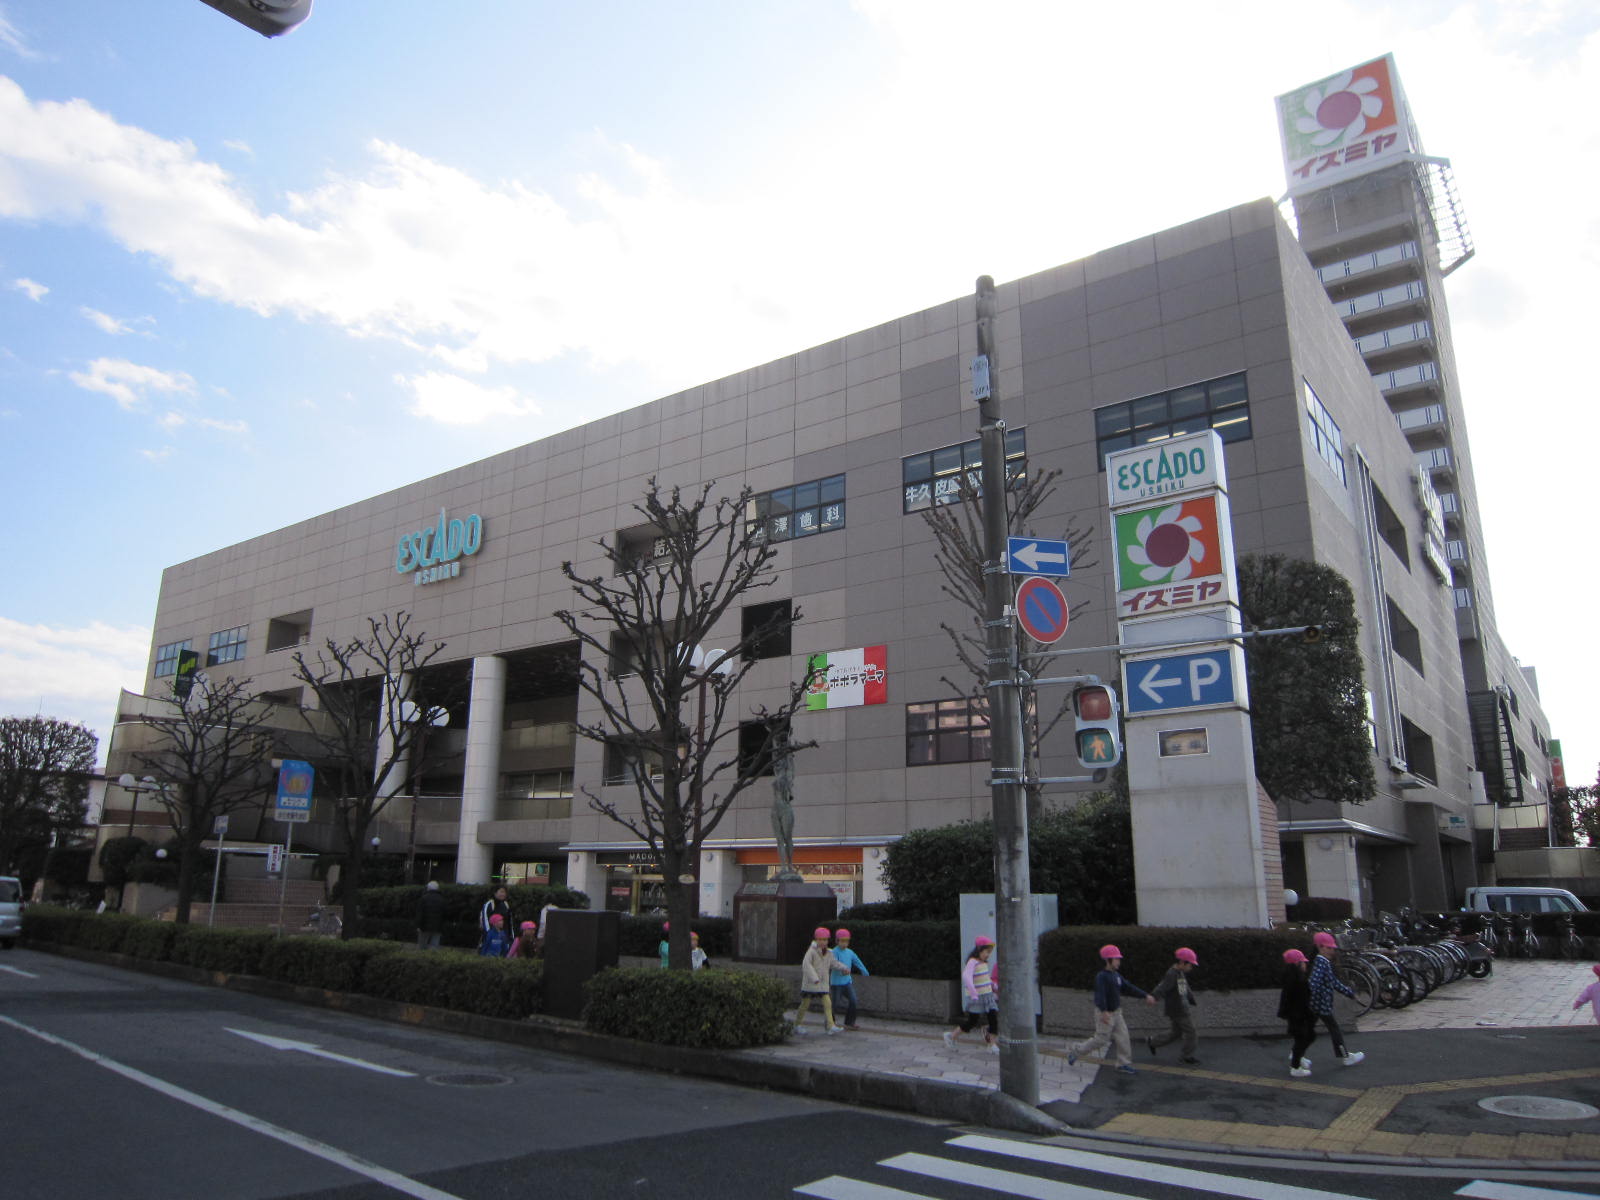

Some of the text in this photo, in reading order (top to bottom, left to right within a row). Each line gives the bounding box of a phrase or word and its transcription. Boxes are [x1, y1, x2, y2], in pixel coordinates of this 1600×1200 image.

[1292, 132, 1397, 179] イズミヤ
[1117, 446, 1206, 491] ESCADO
[1140, 480, 1185, 497] USHIKU
[396, 507, 482, 574] ESCADO
[1123, 582, 1222, 612] イズミヤ
[1189, 657, 1222, 701] P
